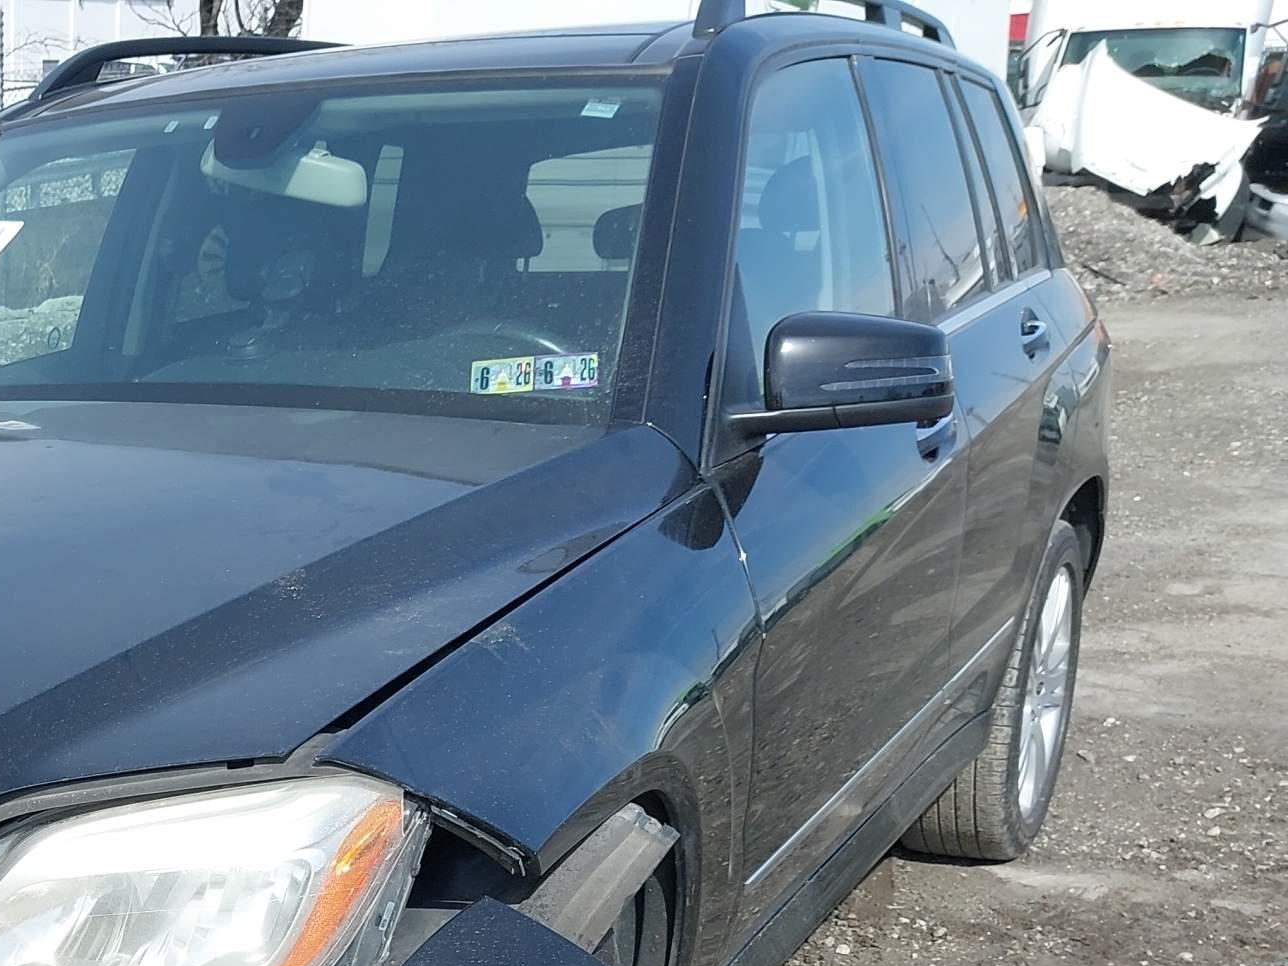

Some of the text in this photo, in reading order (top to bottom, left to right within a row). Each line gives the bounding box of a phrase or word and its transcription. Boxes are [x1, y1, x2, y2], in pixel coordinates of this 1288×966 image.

[479, 366, 490, 390] 6
[543, 357, 596, 384] 6 26
